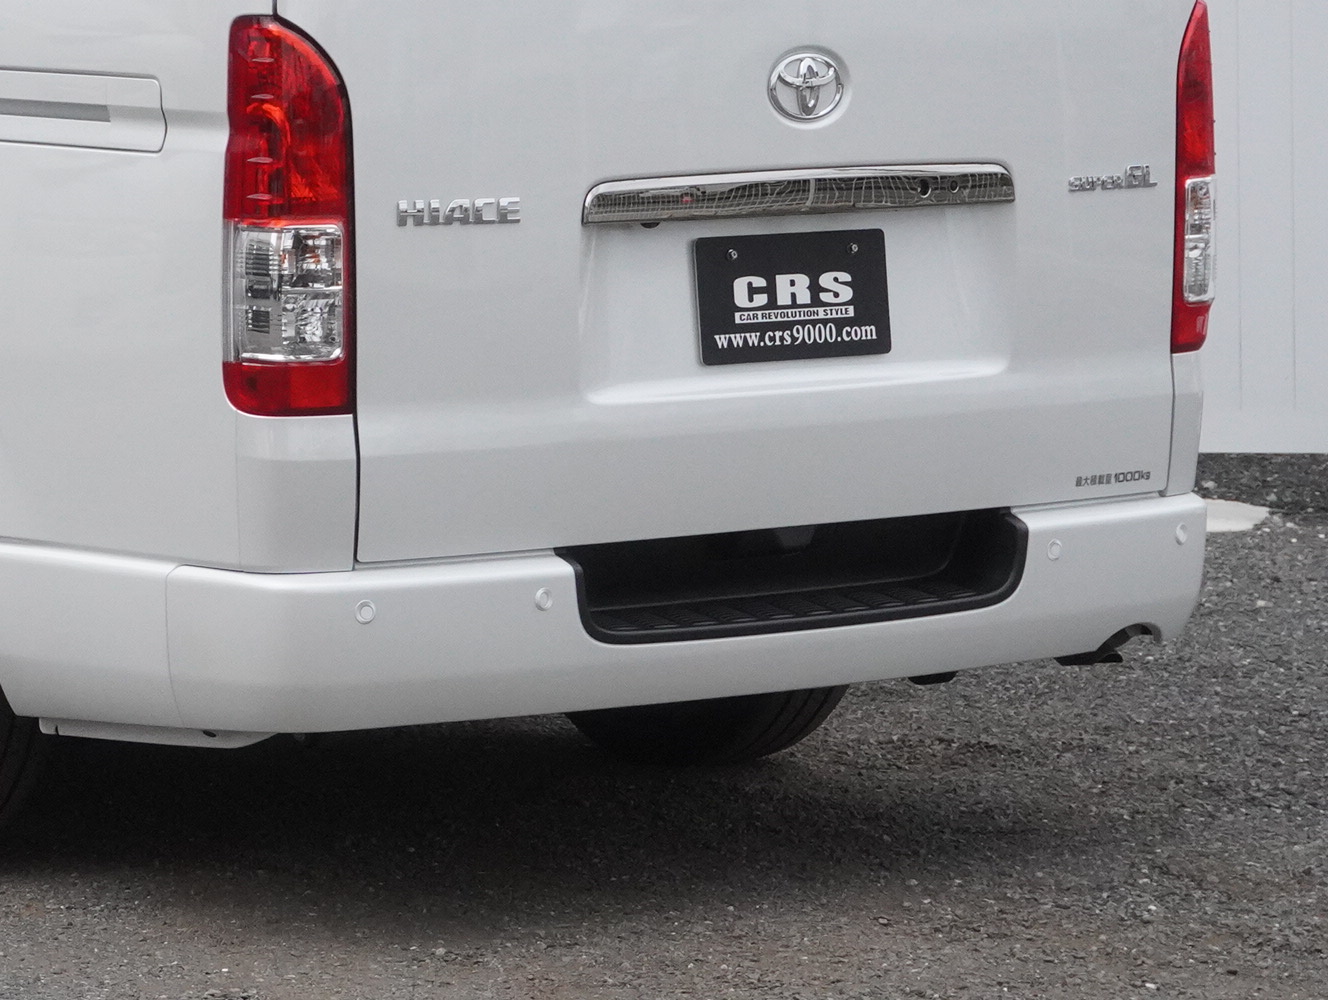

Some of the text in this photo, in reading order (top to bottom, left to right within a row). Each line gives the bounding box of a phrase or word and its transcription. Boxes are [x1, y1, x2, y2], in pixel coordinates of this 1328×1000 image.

[397, 197, 521, 227] HIACE
[733, 271, 854, 308] CRS
[739, 307, 850, 322] CAR REVOLUTION STYLE
[714, 322, 877, 349] www.crs9000.com
